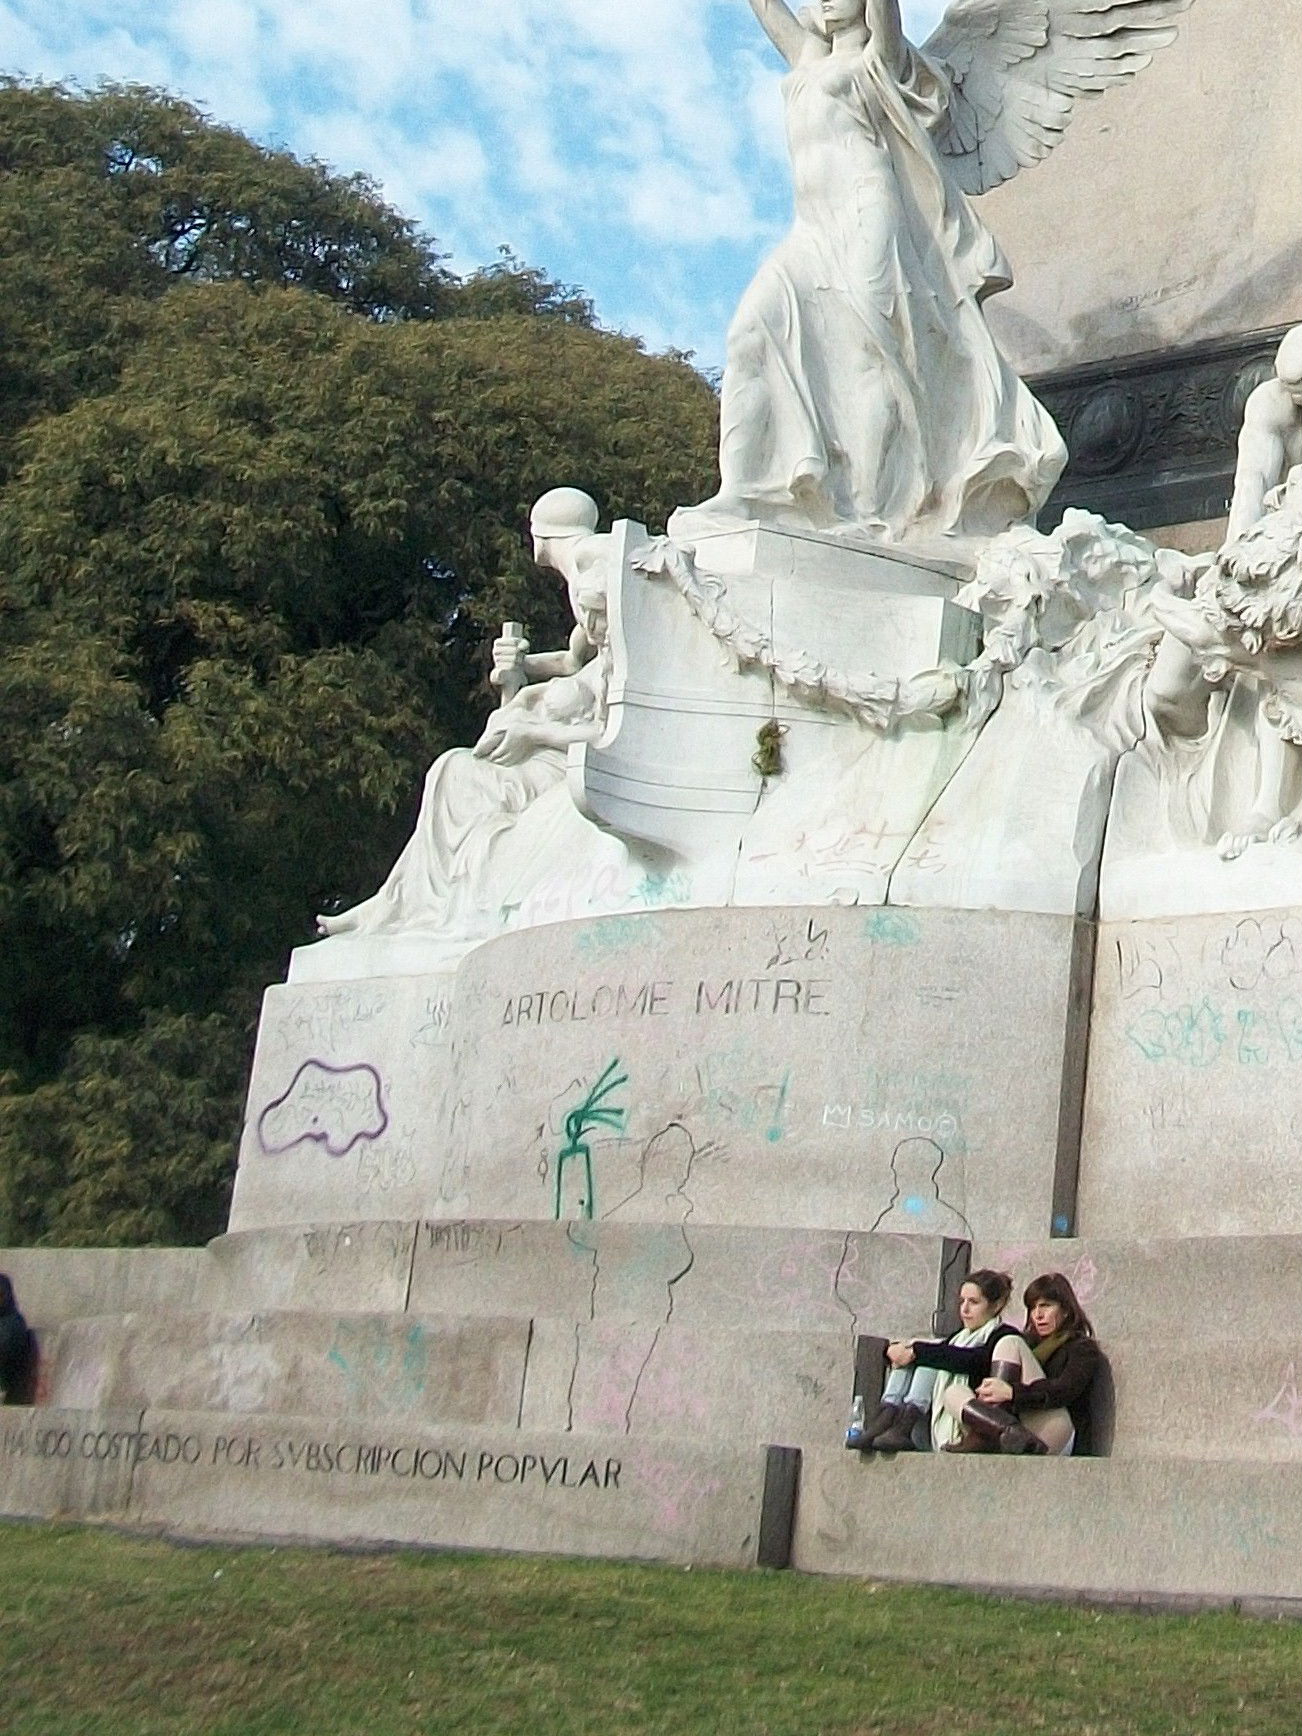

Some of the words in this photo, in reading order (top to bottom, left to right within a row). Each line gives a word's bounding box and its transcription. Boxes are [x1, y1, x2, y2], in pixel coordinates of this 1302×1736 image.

[695, 977, 834, 1017] MITRE
[81, 1430, 201, 1465] COSTEADO
[211, 1433, 260, 1469] POR
[273, 1436, 468, 1481] SVBSCRIPCION
[476, 1450, 623, 1490] POPVLAR
